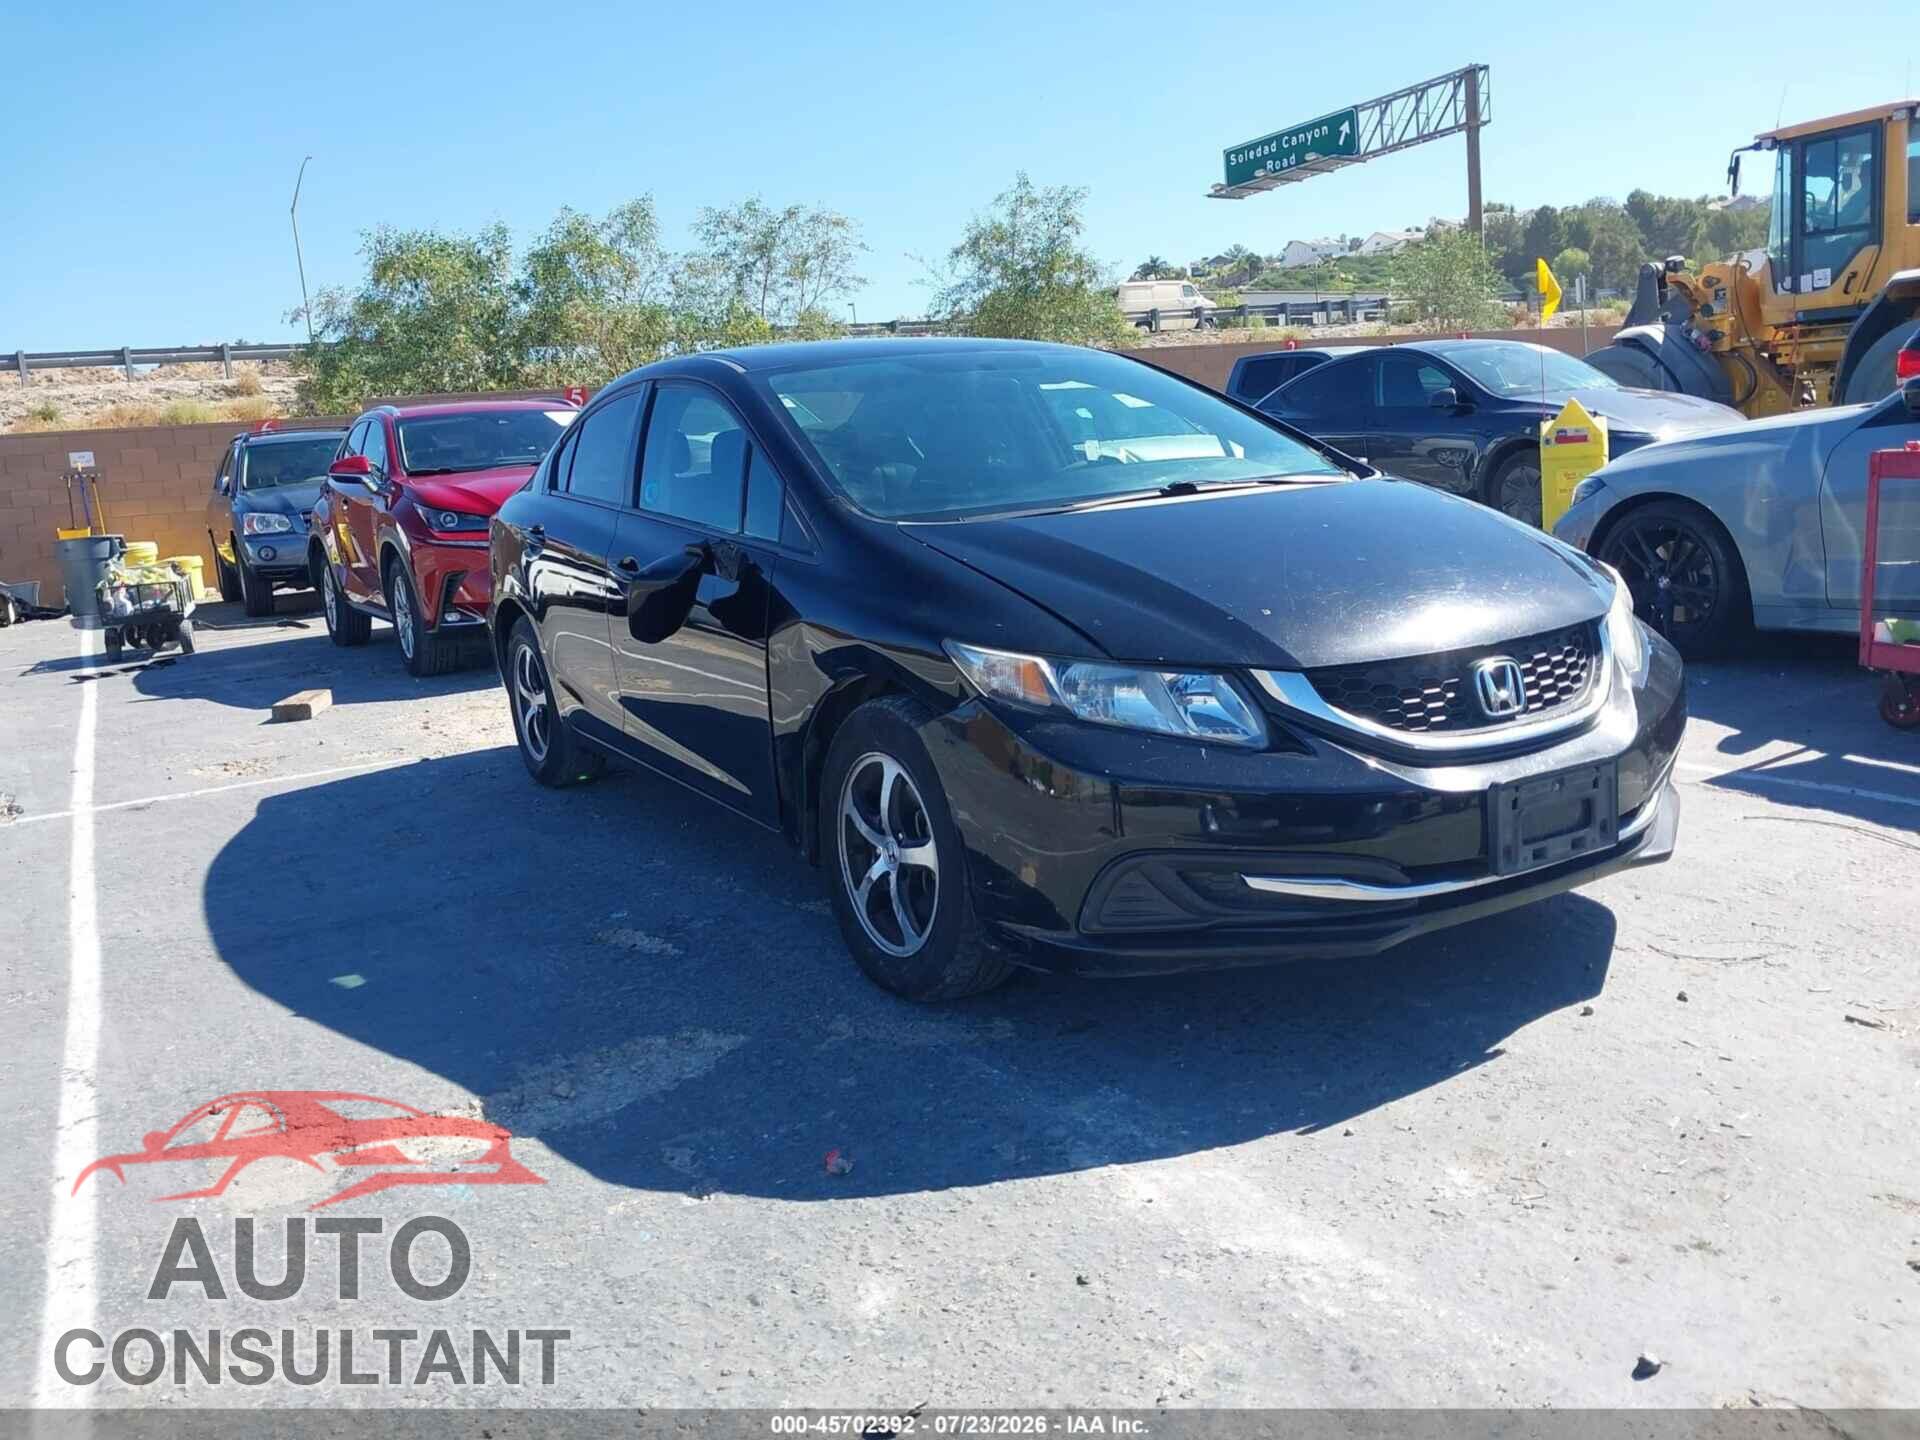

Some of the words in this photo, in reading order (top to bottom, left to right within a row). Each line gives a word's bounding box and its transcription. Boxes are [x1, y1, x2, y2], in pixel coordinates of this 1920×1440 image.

[1229, 140, 1277, 166] Soledad
[1282, 125, 1329, 148] Canyon
[1266, 153, 1296, 171] Road
[571, 389, 584, 408] 5
